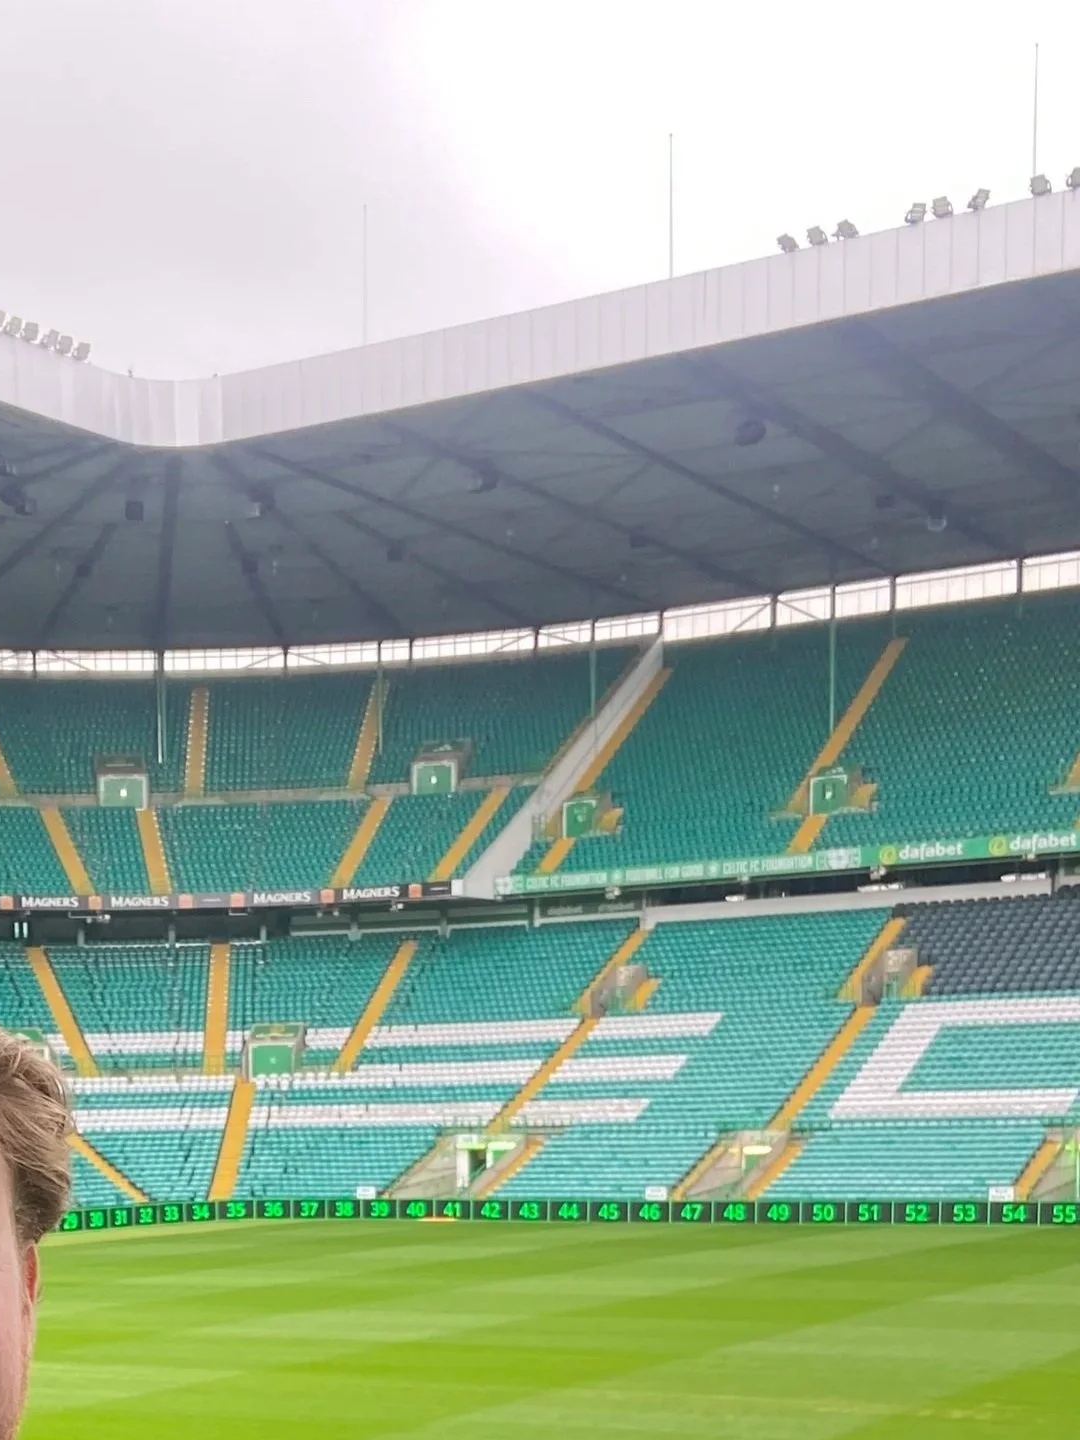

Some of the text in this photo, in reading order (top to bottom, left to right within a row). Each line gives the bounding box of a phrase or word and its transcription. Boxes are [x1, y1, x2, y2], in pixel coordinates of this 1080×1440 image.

[1008, 832, 1078, 854] dafabet
[898, 842, 964, 862] dafabet
[252, 890, 312, 905] MAGNERS
[342, 885, 400, 901] MAGNERS
[21, 895, 79, 909] MAGNERS
[111, 895, 170, 908] MAGNERS
[63, 1201, 1078, 1232] 29 30 31 32 33 34 35 36 37 38 39 40 41 42 43 44 45 46 47 48 49 50 51 52 53 54 55
